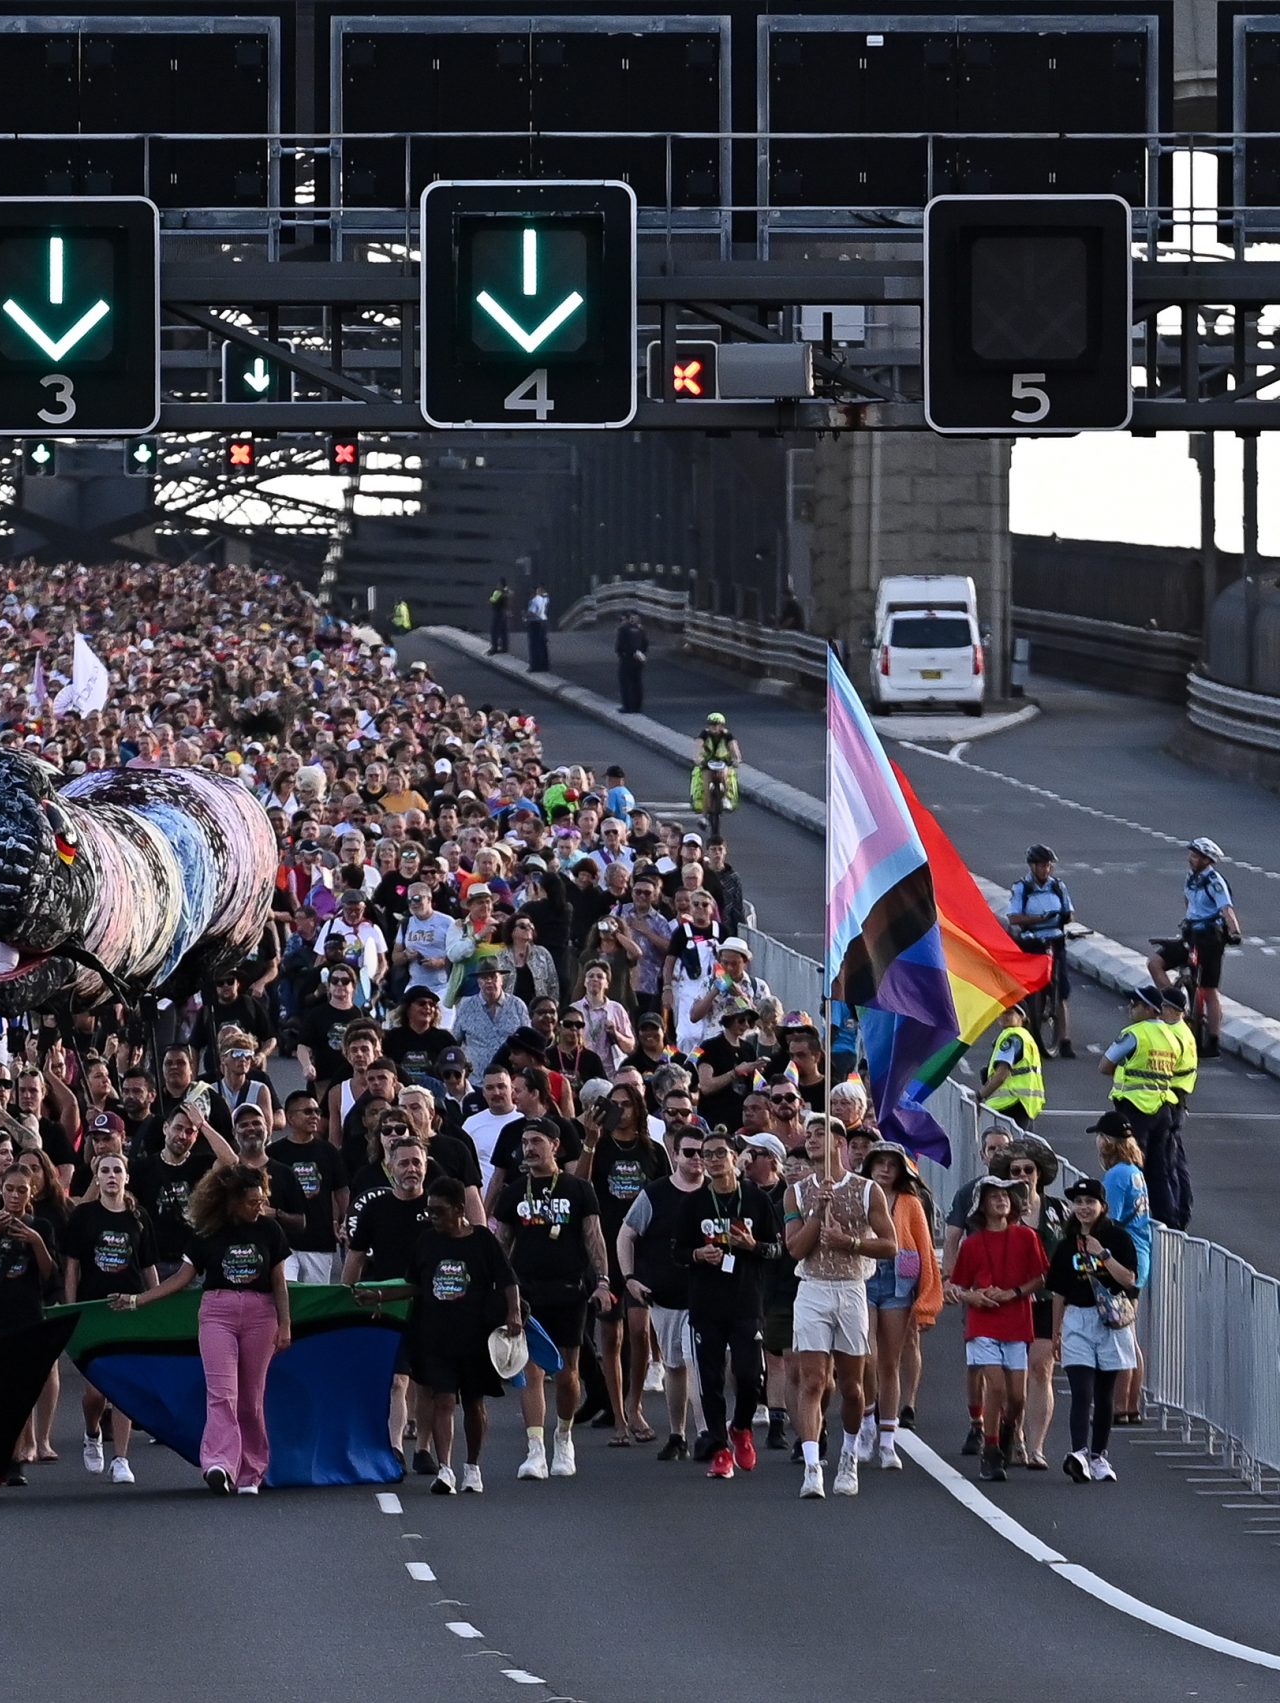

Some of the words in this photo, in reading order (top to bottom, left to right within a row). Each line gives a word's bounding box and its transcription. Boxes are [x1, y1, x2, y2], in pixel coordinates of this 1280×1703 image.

[37, 374, 77, 425] 3
[504, 369, 555, 421] 4
[1010, 373, 1051, 423] 5
[517, 1198, 571, 1220] QUER
